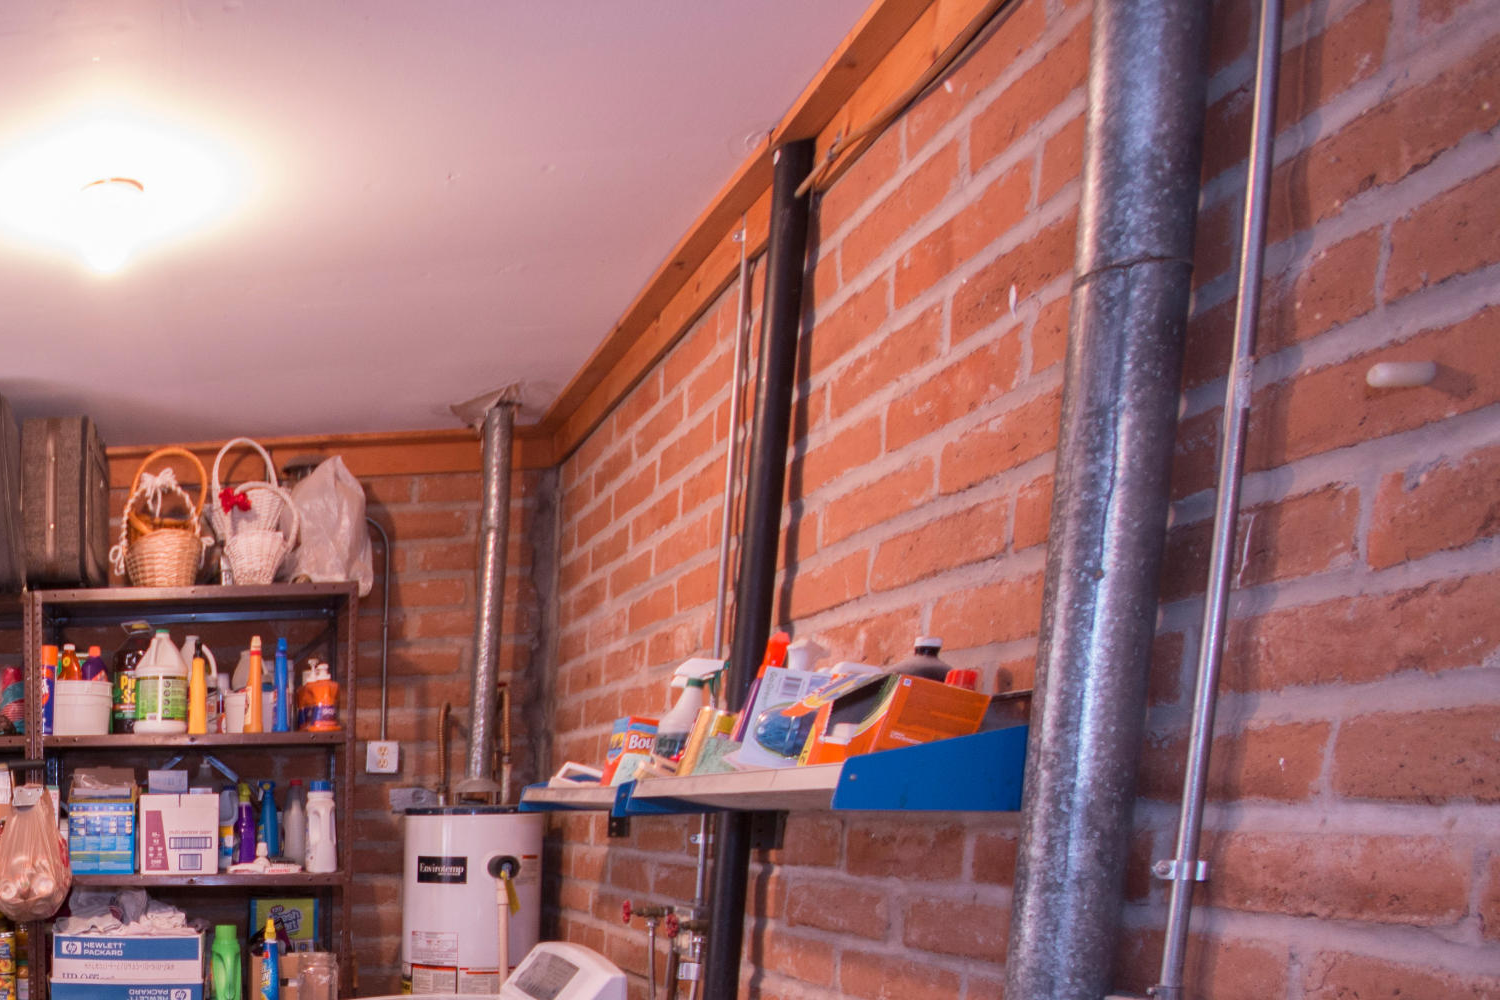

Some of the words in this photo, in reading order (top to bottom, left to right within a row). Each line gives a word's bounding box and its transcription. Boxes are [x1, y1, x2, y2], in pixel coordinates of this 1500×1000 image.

[419, 862, 464, 876] Envirotemp
[66, 941, 78, 954] hp
[174, 989, 187, 1000] hp
